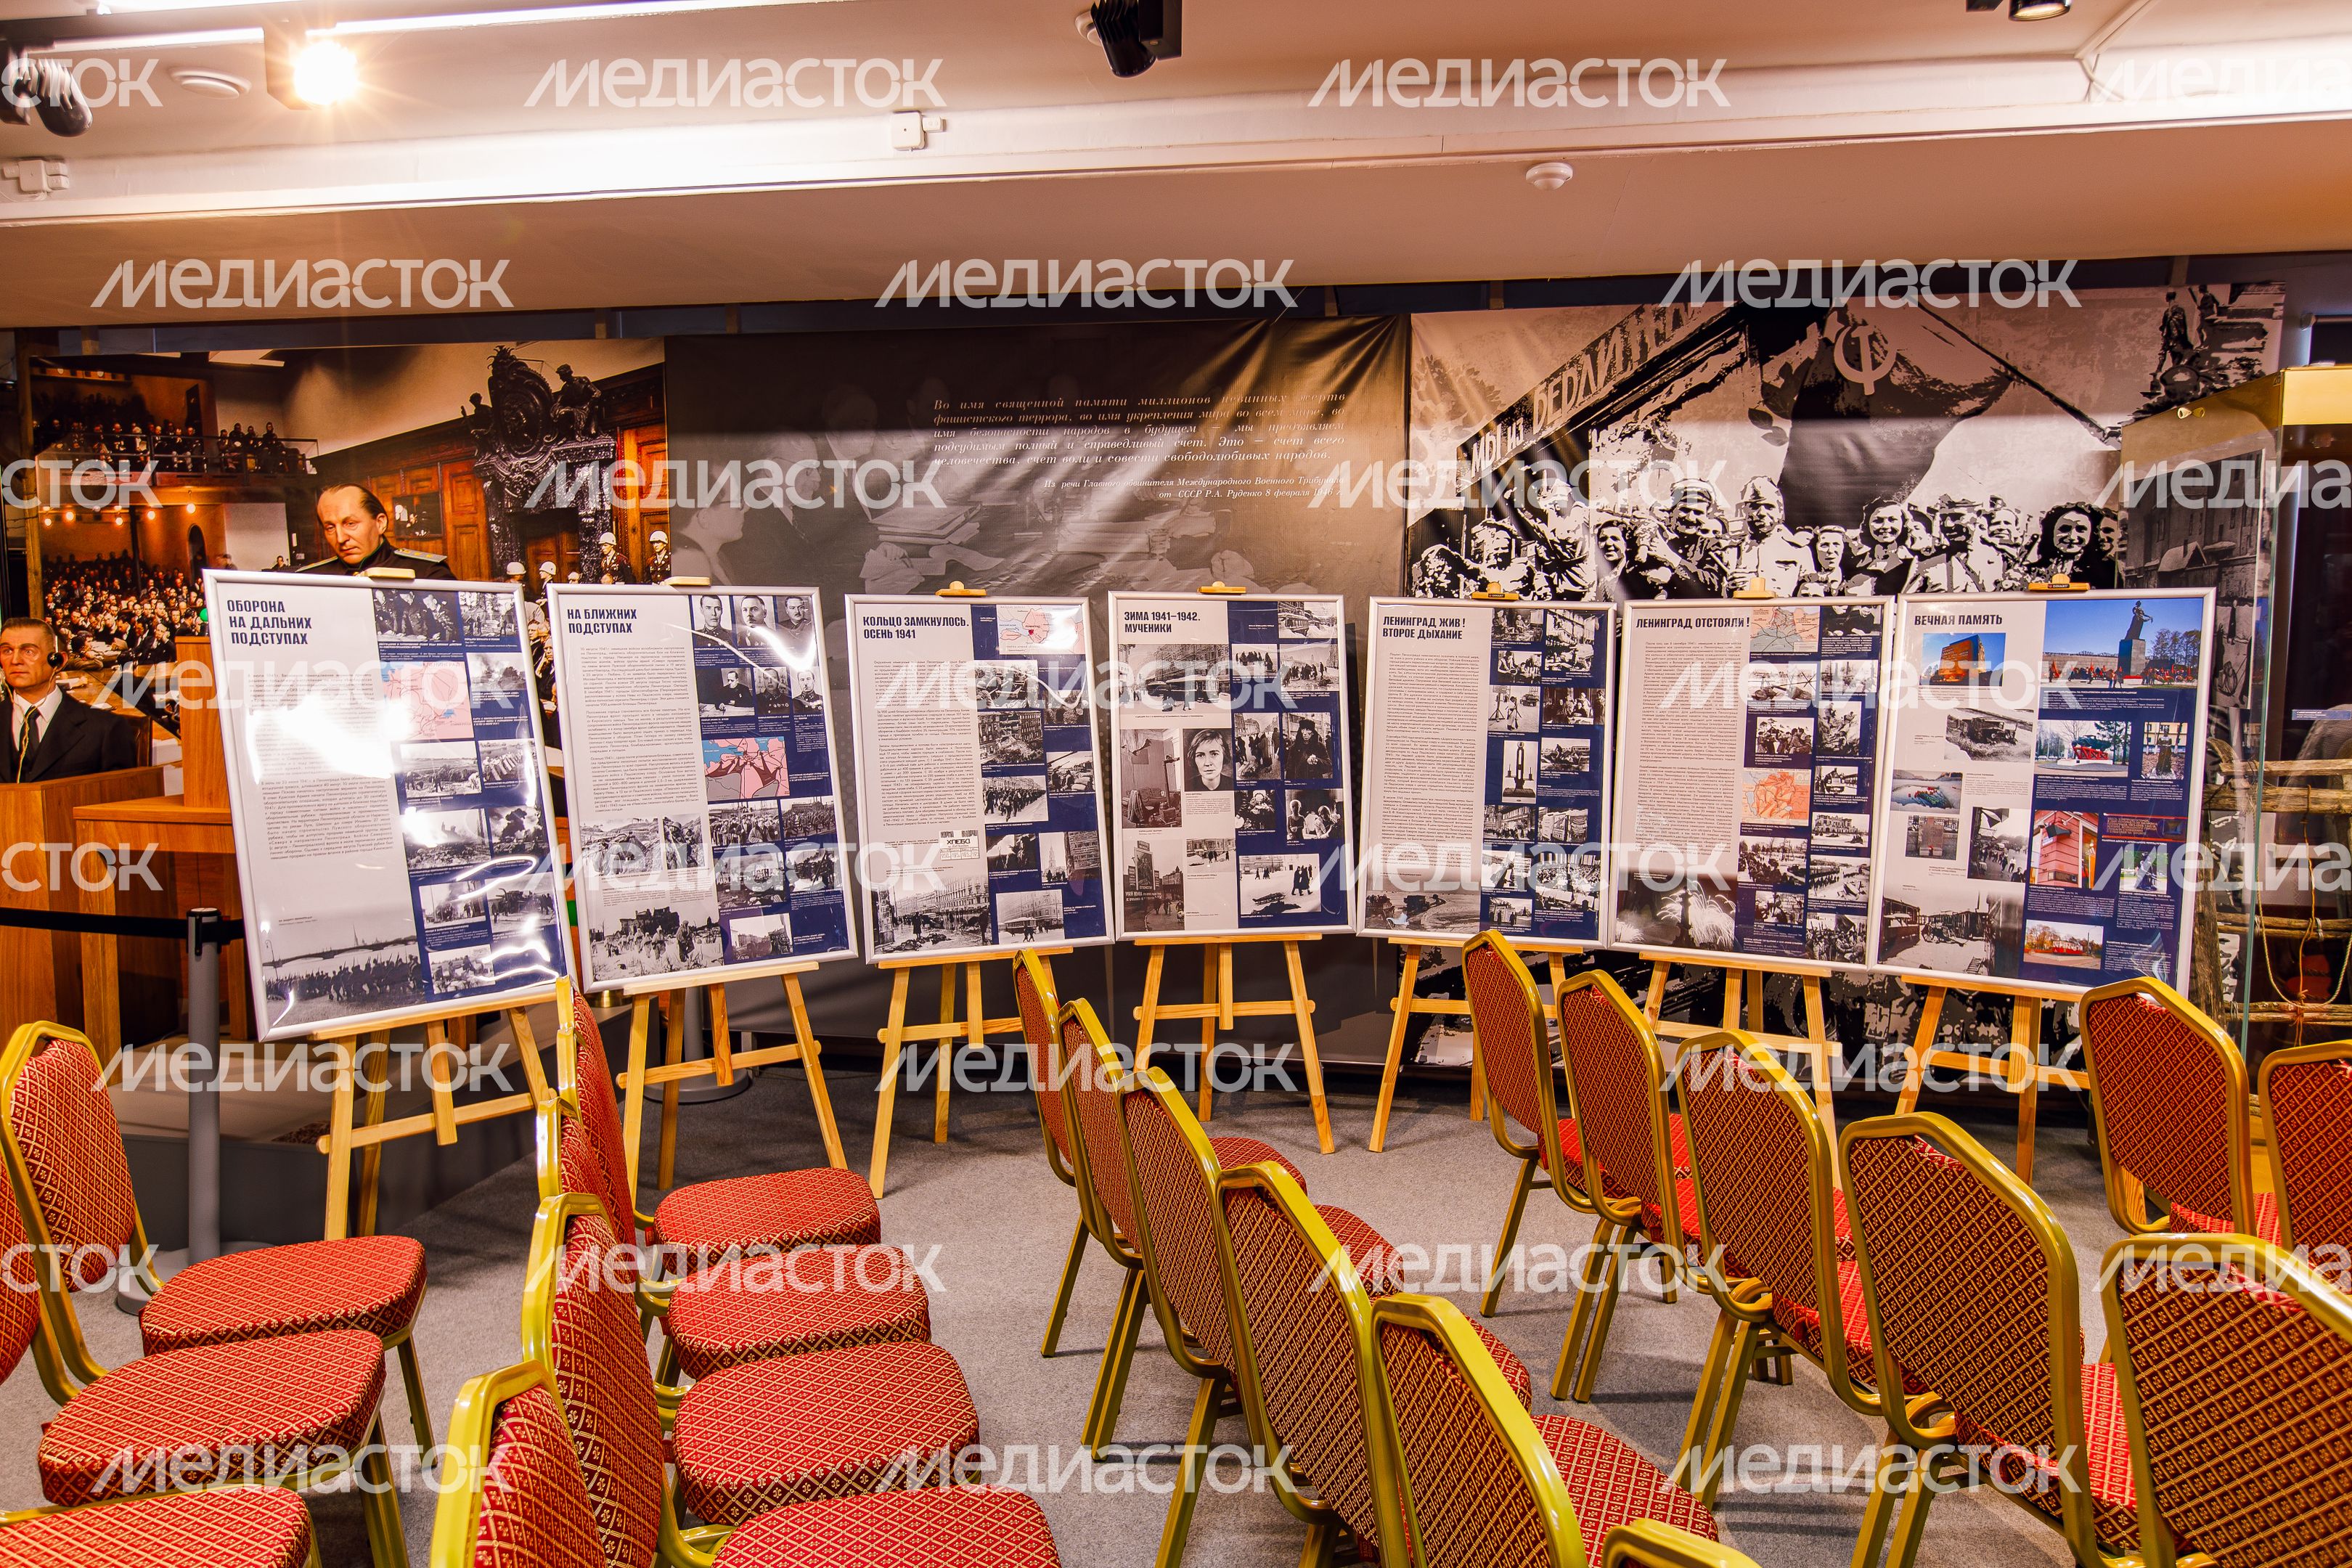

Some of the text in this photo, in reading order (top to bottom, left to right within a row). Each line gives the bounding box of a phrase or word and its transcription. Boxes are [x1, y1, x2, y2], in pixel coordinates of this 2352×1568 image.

[934, 393, 1346, 411] Во имя священной памяти миллионов невинных жертв
[934, 414, 1013, 426] фашистского
[1018, 413, 1072, 424] террора,
[1079, 412, 1093, 421] во
[1098, 412, 1121, 421] имя
[1127, 410, 1193, 423] укрепления
[1199, 410, 1230, 422] мира
[1236, 409, 1249, 418] во
[1255, 408, 1283, 417] всем
[1331, 407, 1345, 416] во
[934, 429, 956, 438] имя
[970, 427, 1050, 438] безопасности
[1063, 425, 1110, 437] народов
[1144, 423, 1196, 436] будущем
[1268, 422, 1344, 434] предъявляем
[934, 441, 1005, 454] подсудимым
[1015, 440, 1058, 451] полный
[1084, 438, 1164, 450] справедливый
[1174, 438, 1207, 448] счет.
[1218, 436, 1244, 446] Это
[1273, 437, 1303, 446] счет
[1313, 436, 1344, 446] всего
[934, 449, 1331, 466] человечества, счет воли и совести свободолюбивых народов.
[1044, 475, 1344, 491] Из речи Главного обвинителя Международного Военного Трибунала
[1177, 490, 1203, 499] СССР
[1204, 490, 1223, 499] Р.А.
[1226, 489, 1262, 500] Руденко
[1265, 489, 1271, 497] 8
[1274, 488, 1310, 500] февраля
[227, 600, 285, 613] ОБОРОНА
[567, 609, 637, 619] НА БЛИЖНИХ
[1124, 611, 1149, 621] ЗИМА
[1914, 614, 2002, 626] ВЕЧНАЯ ПАМЯТЬ
[229, 616, 312, 630] НА ДАЛЬНИХ
[863, 616, 969, 627] КОЛЬЦО ЗАМКНУЛОСЬ.
[1383, 616, 1437, 628] ЛЕНИНГРАД
[1636, 618, 1692, 629] ЛЕНИНГРАД
[568, 623, 633, 635] ПОДСТУПАХ
[864, 629, 916, 639] ОСЕНЬ 1941
[1125, 624, 1172, 633] МУЧЕНИКИ
[1382, 628, 1463, 640] ВТОРОЕ ДЫХАНИЕ
[232, 632, 308, 646] ПОДСТУПАХ
